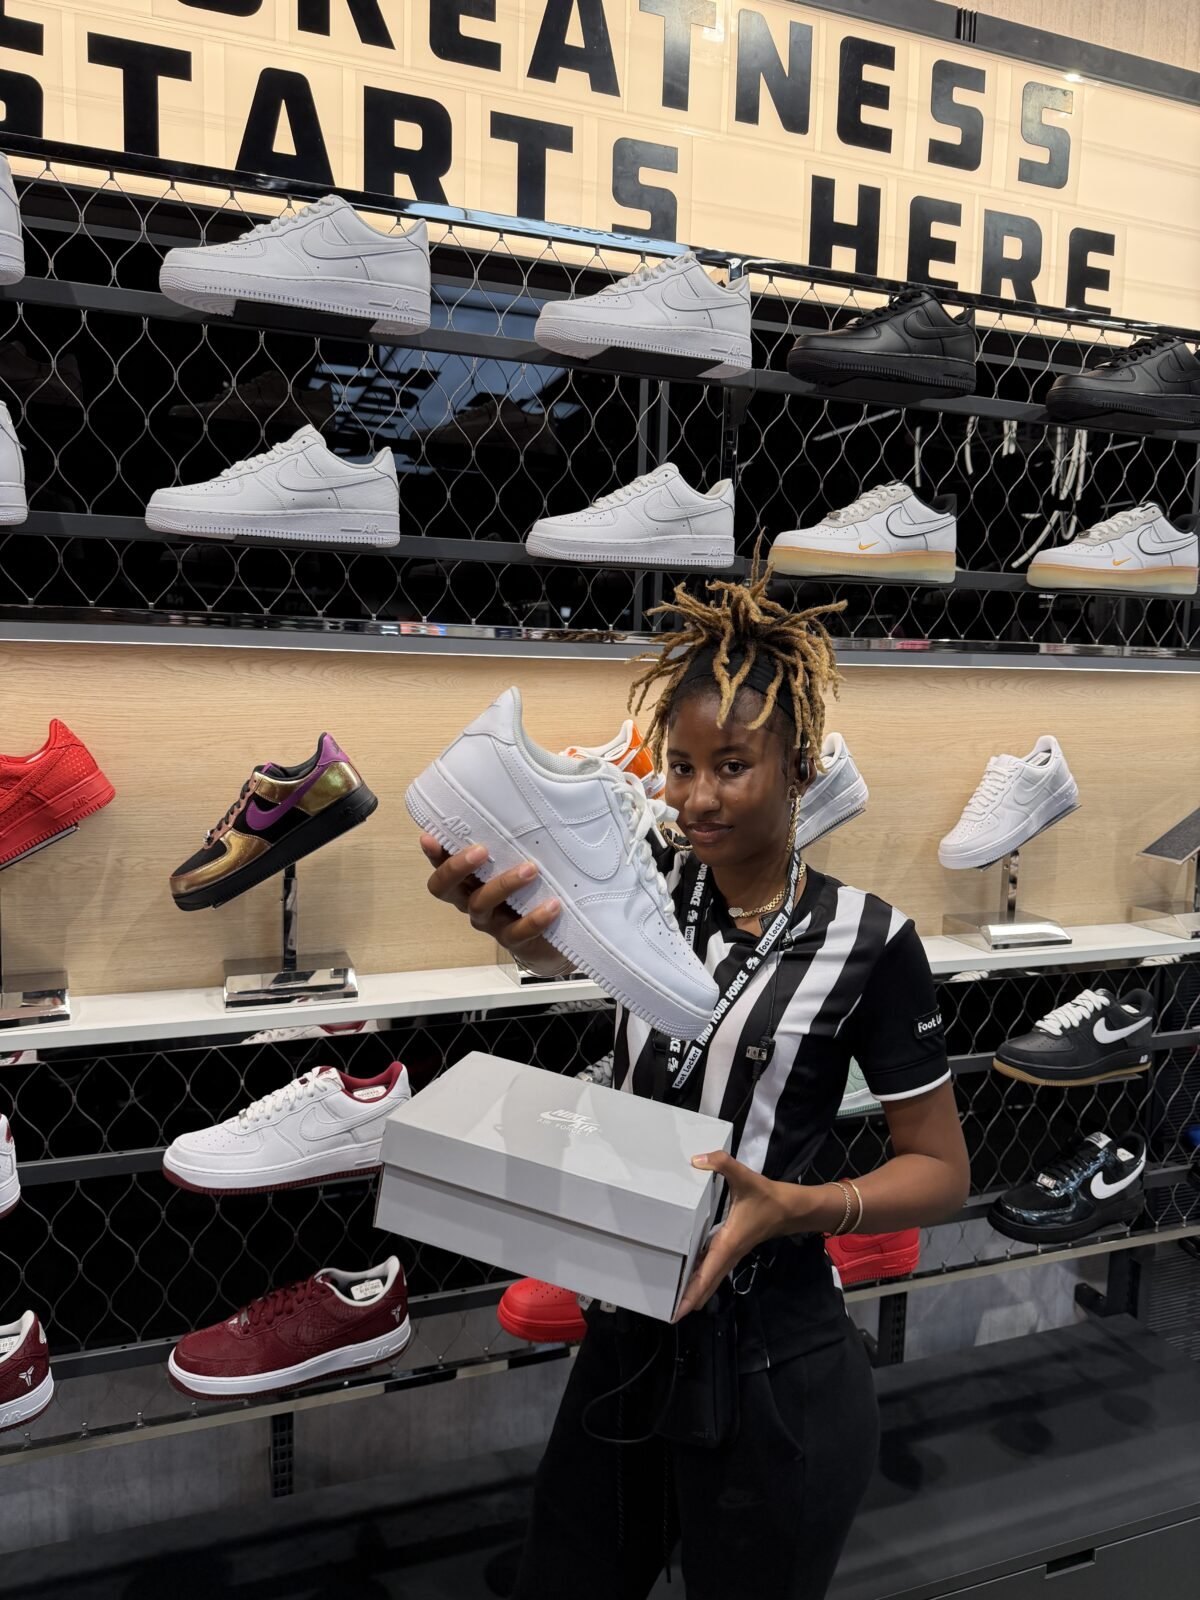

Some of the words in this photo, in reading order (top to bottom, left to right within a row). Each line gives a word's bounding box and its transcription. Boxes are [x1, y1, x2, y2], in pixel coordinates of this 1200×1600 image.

[176, 0, 1074, 190] EATNESS
[808, 174, 1116, 314] HERE
[441, 815, 472, 840] AIR
[690, 881, 704, 907] FORCE
[758, 937, 772, 953] Foot
[769, 916, 786, 938] Locker
[696, 1023, 714, 1046] FIND
[711, 998, 730, 1025] YOUR
[725, 970, 749, 1001] FORCE
[918, 1017, 937, 1033] Foot
[674, 1072, 687, 1088] Foot
[685, 1049, 700, 1075] Locker
